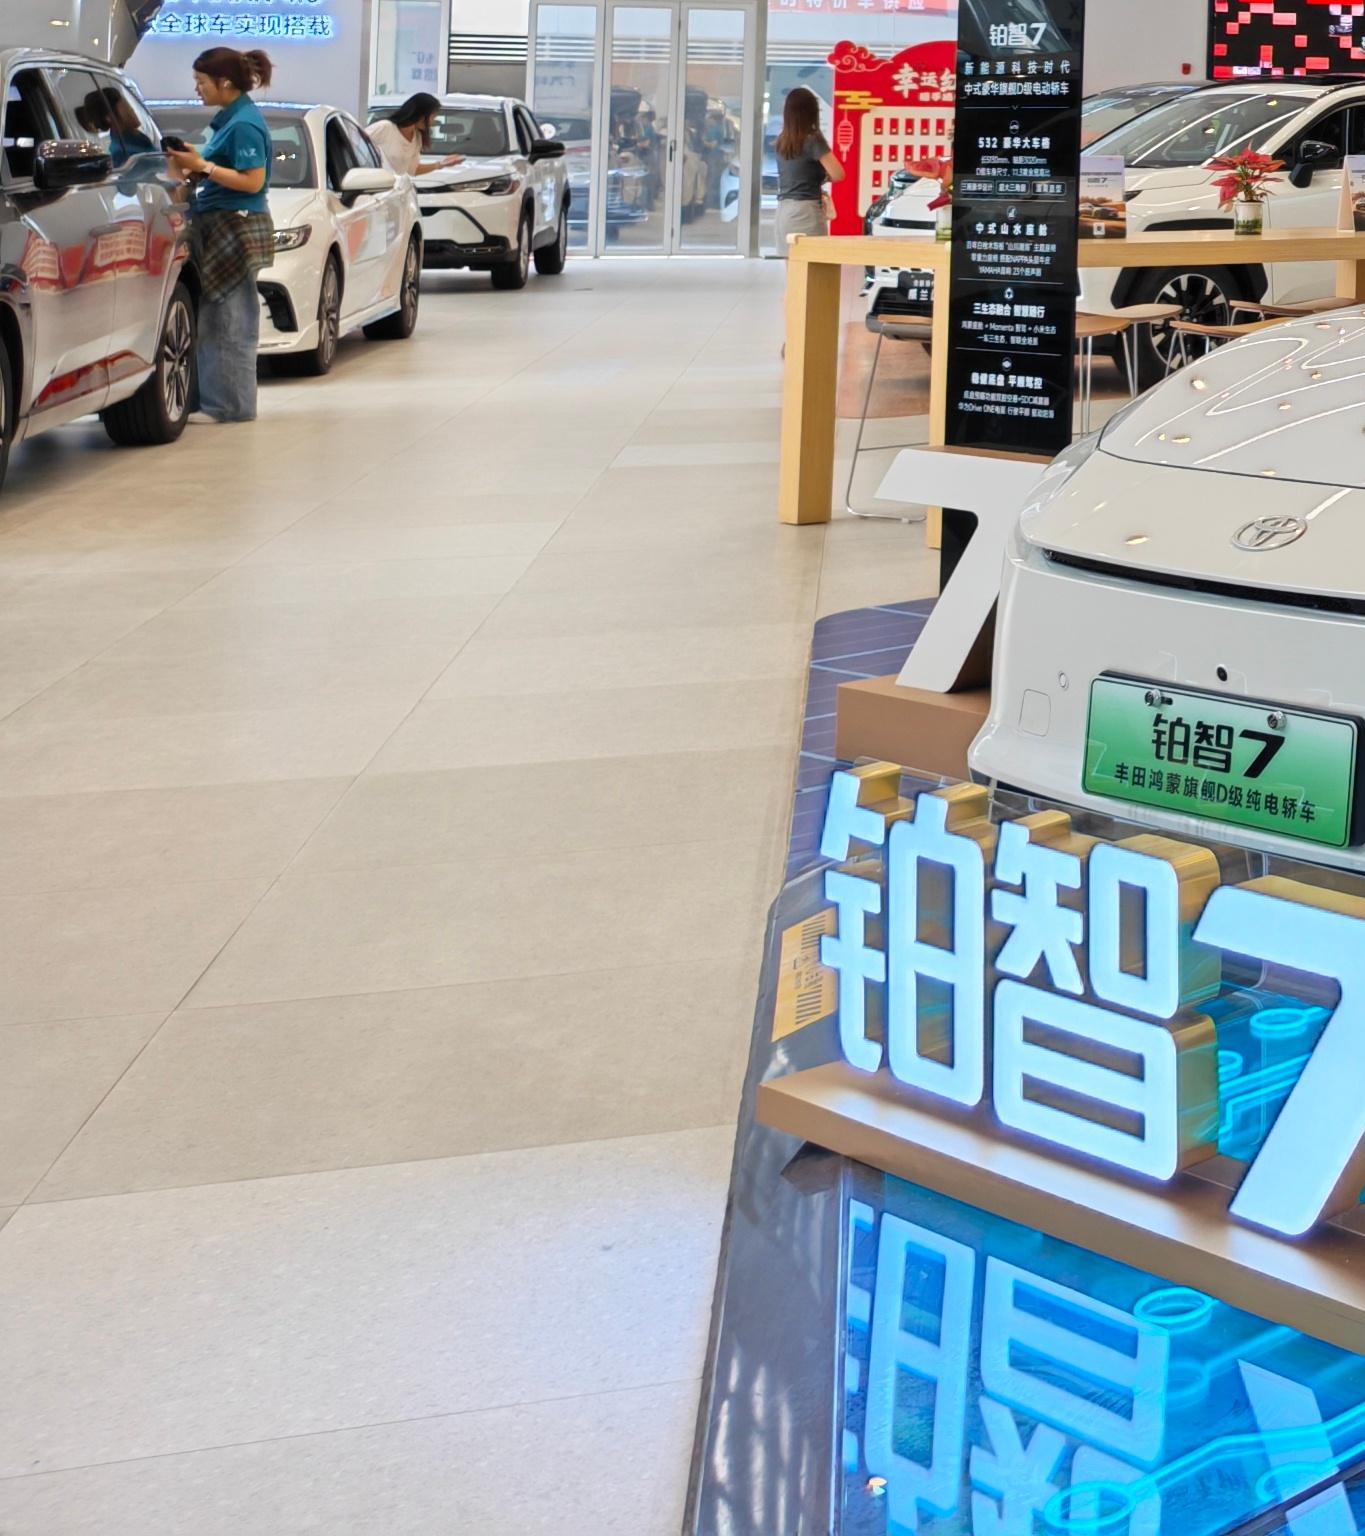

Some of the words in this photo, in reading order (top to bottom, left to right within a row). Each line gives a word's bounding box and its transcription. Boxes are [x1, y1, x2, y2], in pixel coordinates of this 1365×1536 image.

[989, 22, 1048, 46] 铂智7
[1151, 713, 1286, 779] 铂智7
[1113, 762, 1317, 824] 丰田鸿蒙旗舰D级纯电轿车
